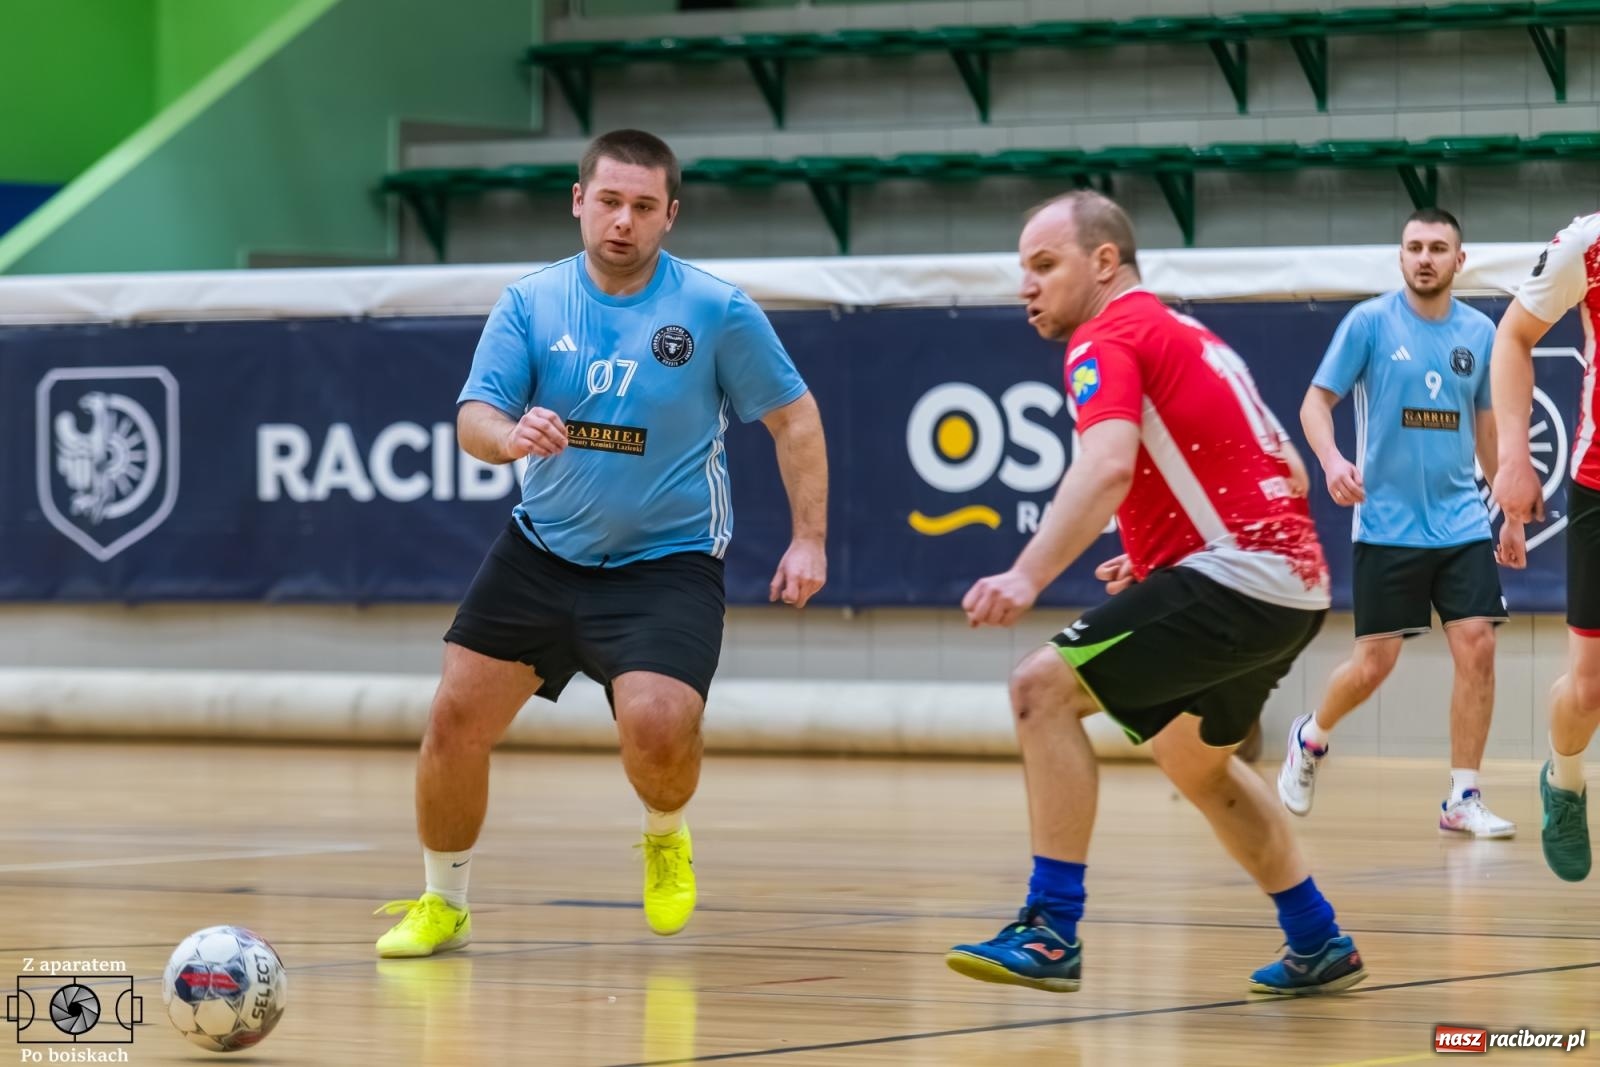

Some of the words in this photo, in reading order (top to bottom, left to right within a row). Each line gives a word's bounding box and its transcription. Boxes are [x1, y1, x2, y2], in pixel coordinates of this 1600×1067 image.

[586, 359, 638, 397] 07
[1424, 370, 1442, 400] 9
[566, 424, 645, 444] GABRIEL
[255, 421, 529, 501] RACIB
[251, 953, 271, 1020] SELECT
